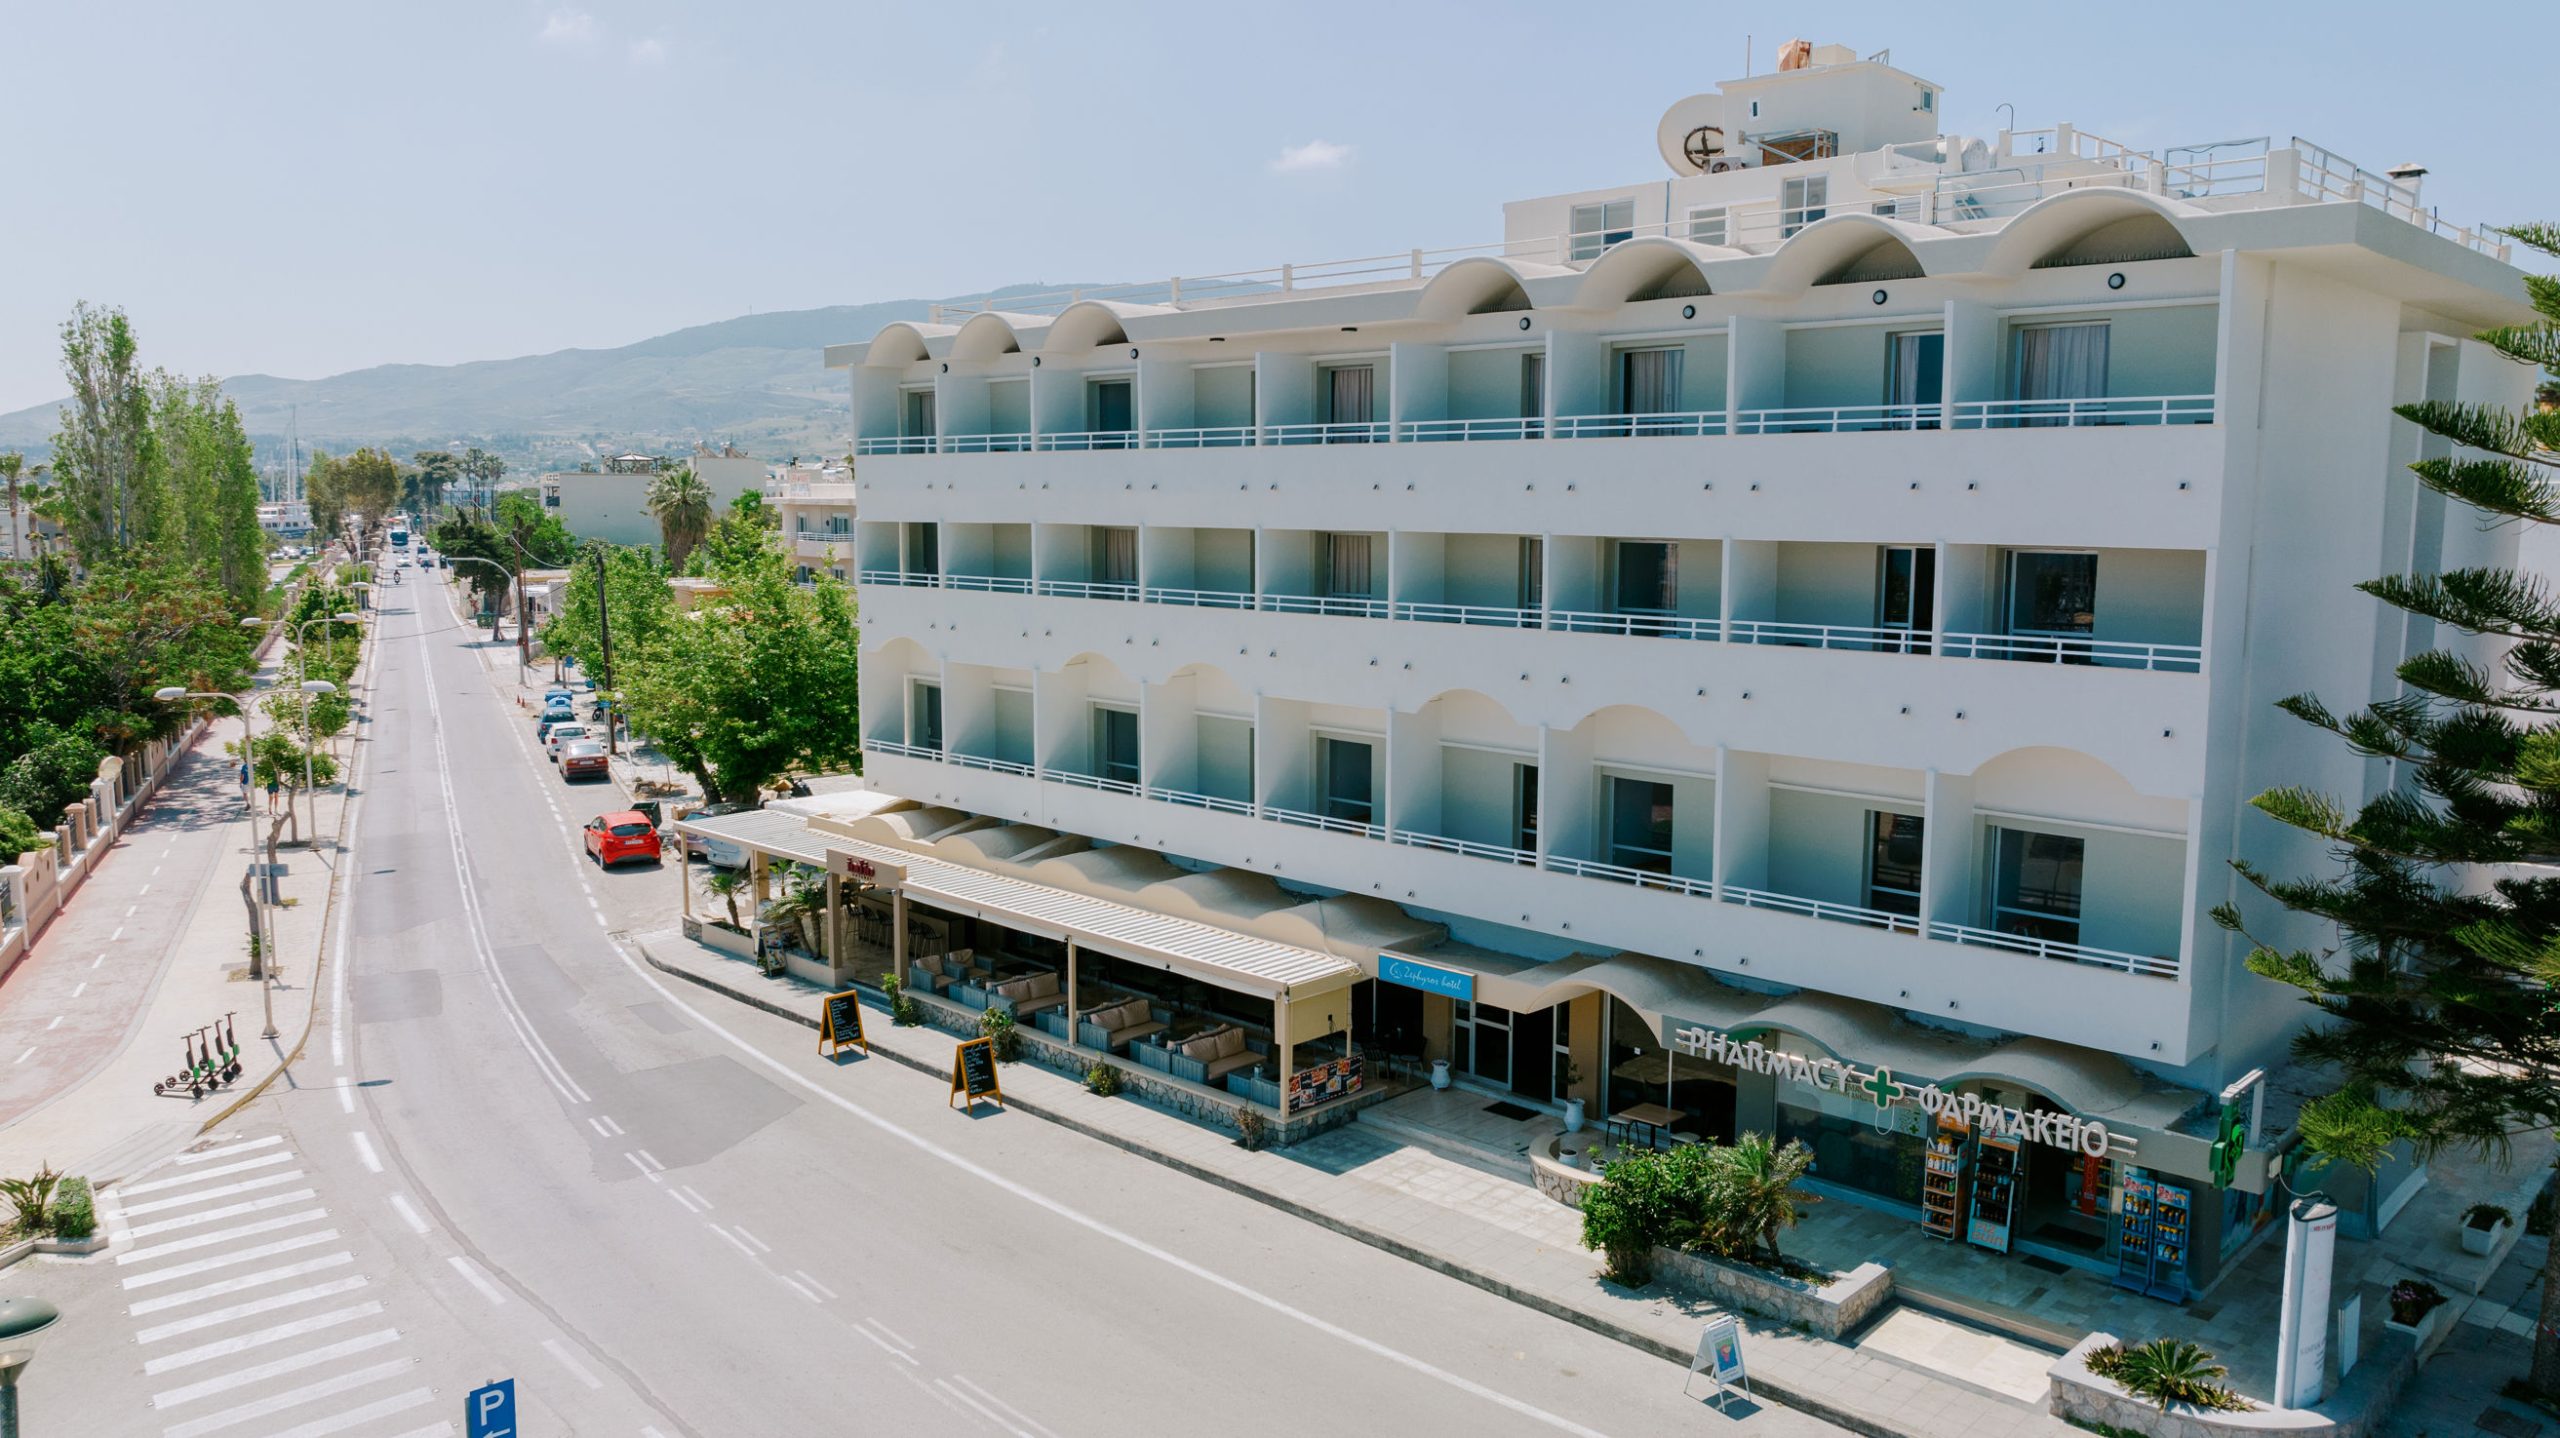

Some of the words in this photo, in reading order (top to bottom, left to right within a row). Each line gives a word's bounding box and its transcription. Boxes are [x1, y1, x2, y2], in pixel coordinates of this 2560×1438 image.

[1404, 966, 1439, 986] Zephyros
[1441, 975, 1462, 991] hotel
[1690, 1027, 1856, 1093] PHARMACY
[1919, 1083, 2109, 1158] ΦΑΡΜΑΚΕΙΟ
[480, 1389, 505, 1427] P
